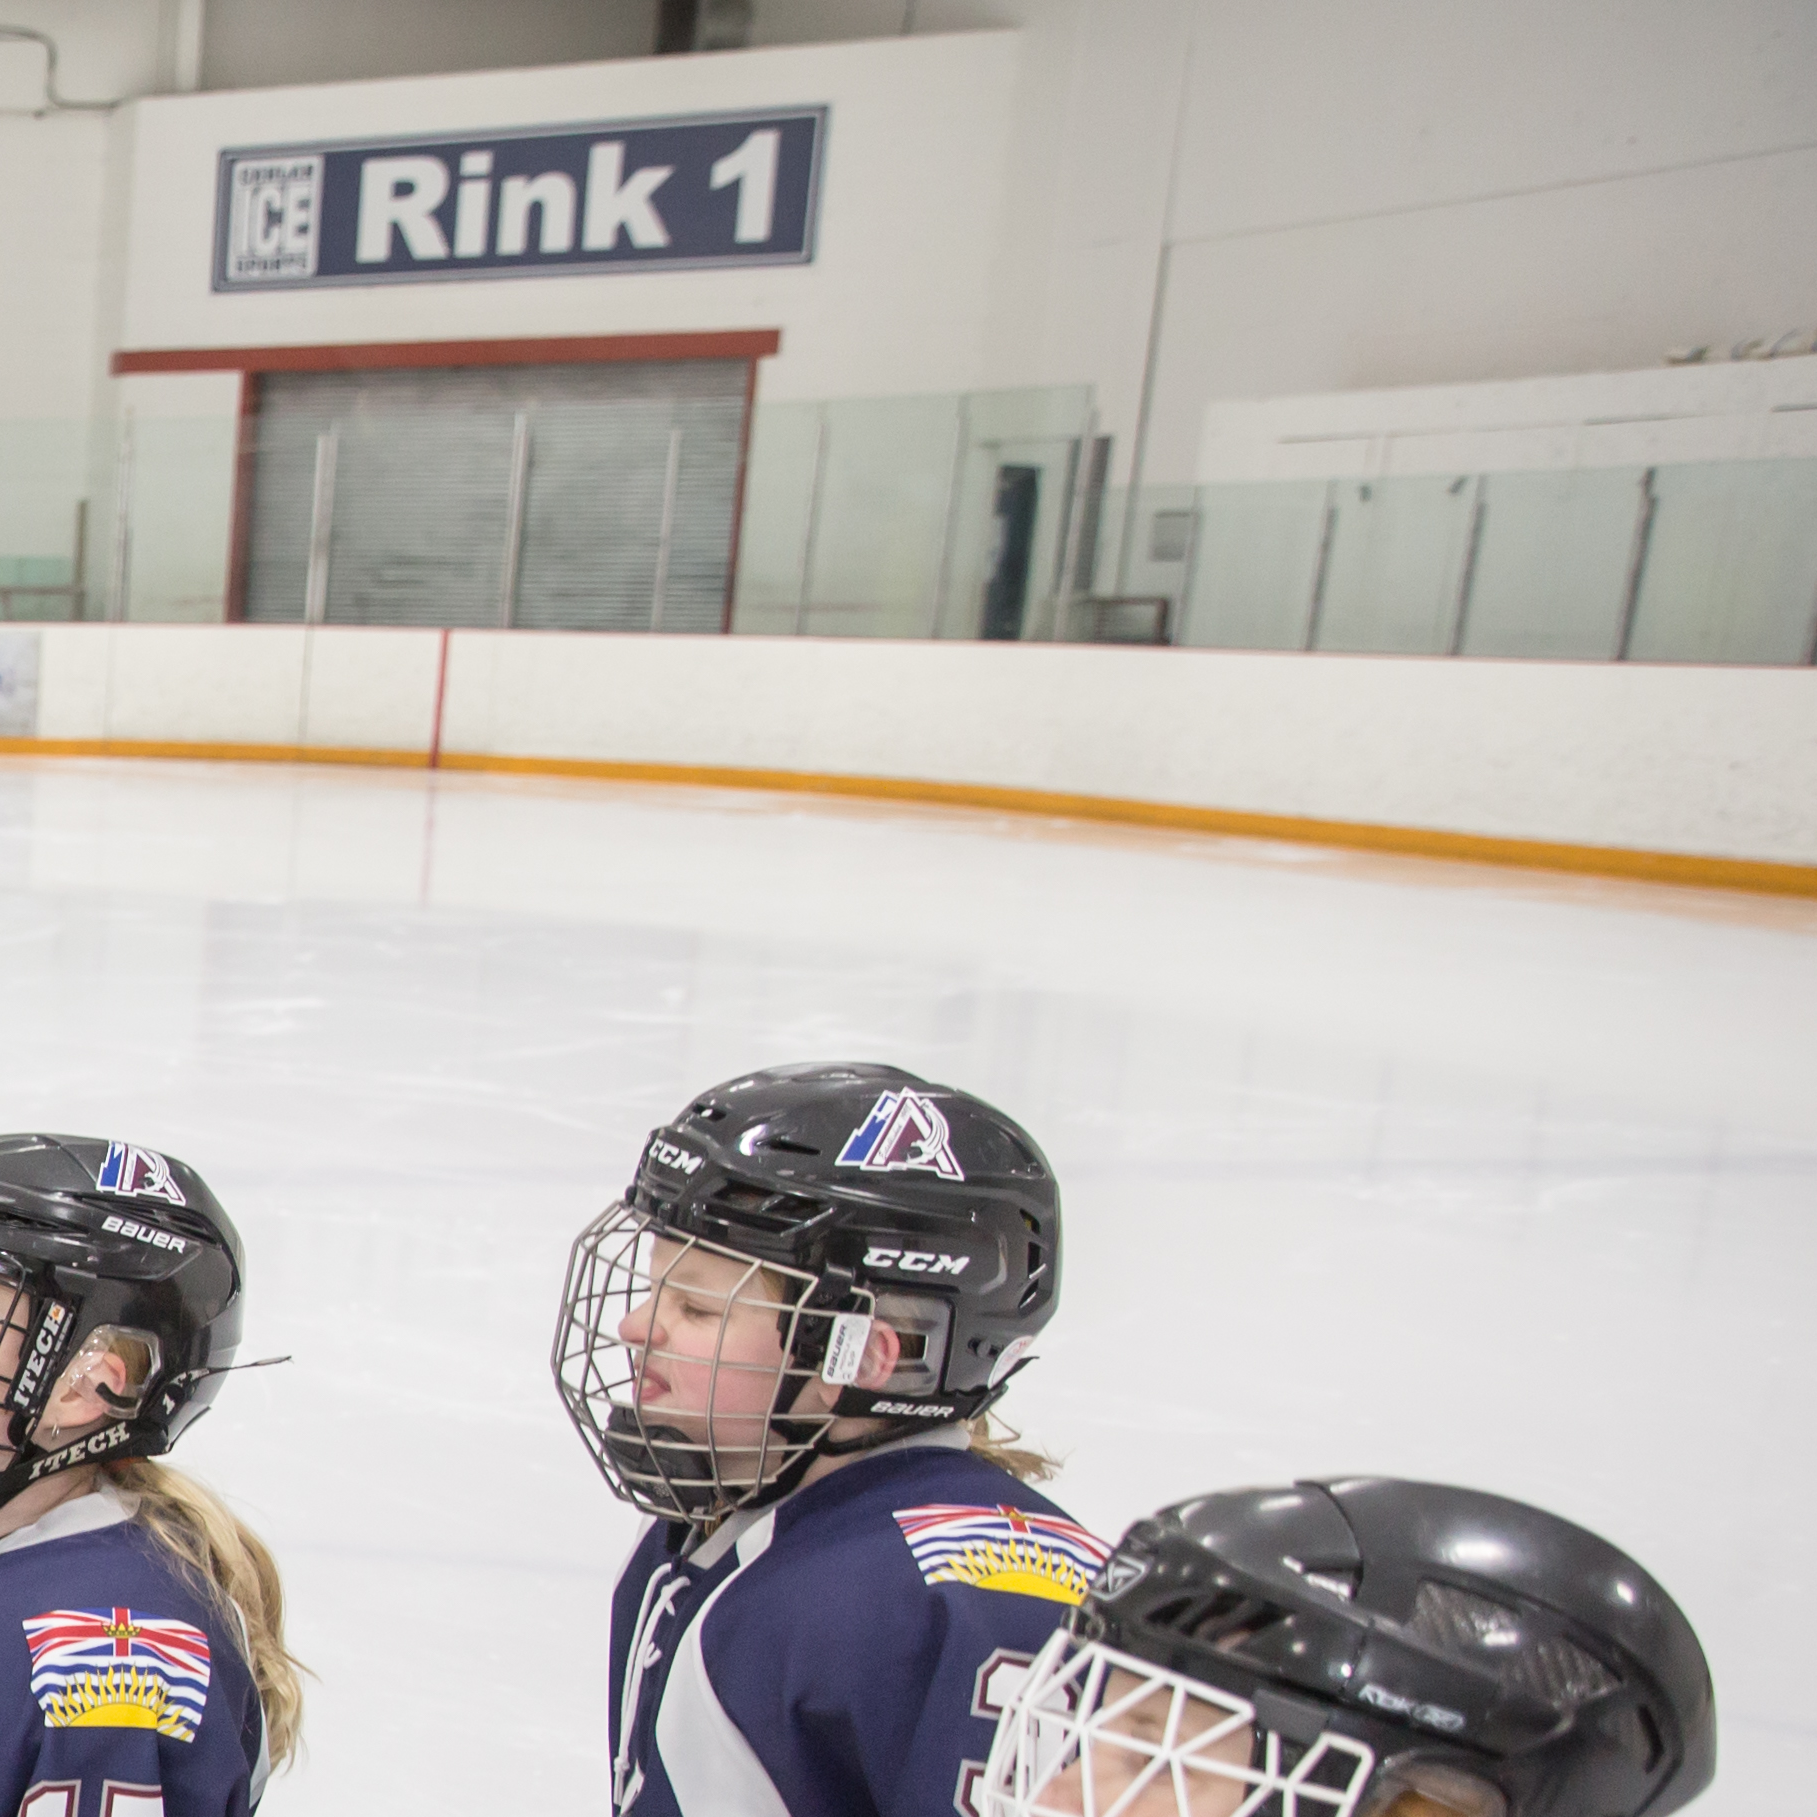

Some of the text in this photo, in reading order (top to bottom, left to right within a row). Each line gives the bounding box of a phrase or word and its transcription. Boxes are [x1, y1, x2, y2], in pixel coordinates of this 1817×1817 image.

[232, 184, 311, 258] ICE
[354, 128, 782, 265] Rink 1
[648, 1138, 703, 1176] CCM
[100, 1214, 187, 1255] BAUER
[863, 1245, 970, 1275] CCM
[12, 1312, 62, 1409] ITECH
[870, 1400, 955, 1419] BAUER
[28, 1420, 131, 1481] ITECH
